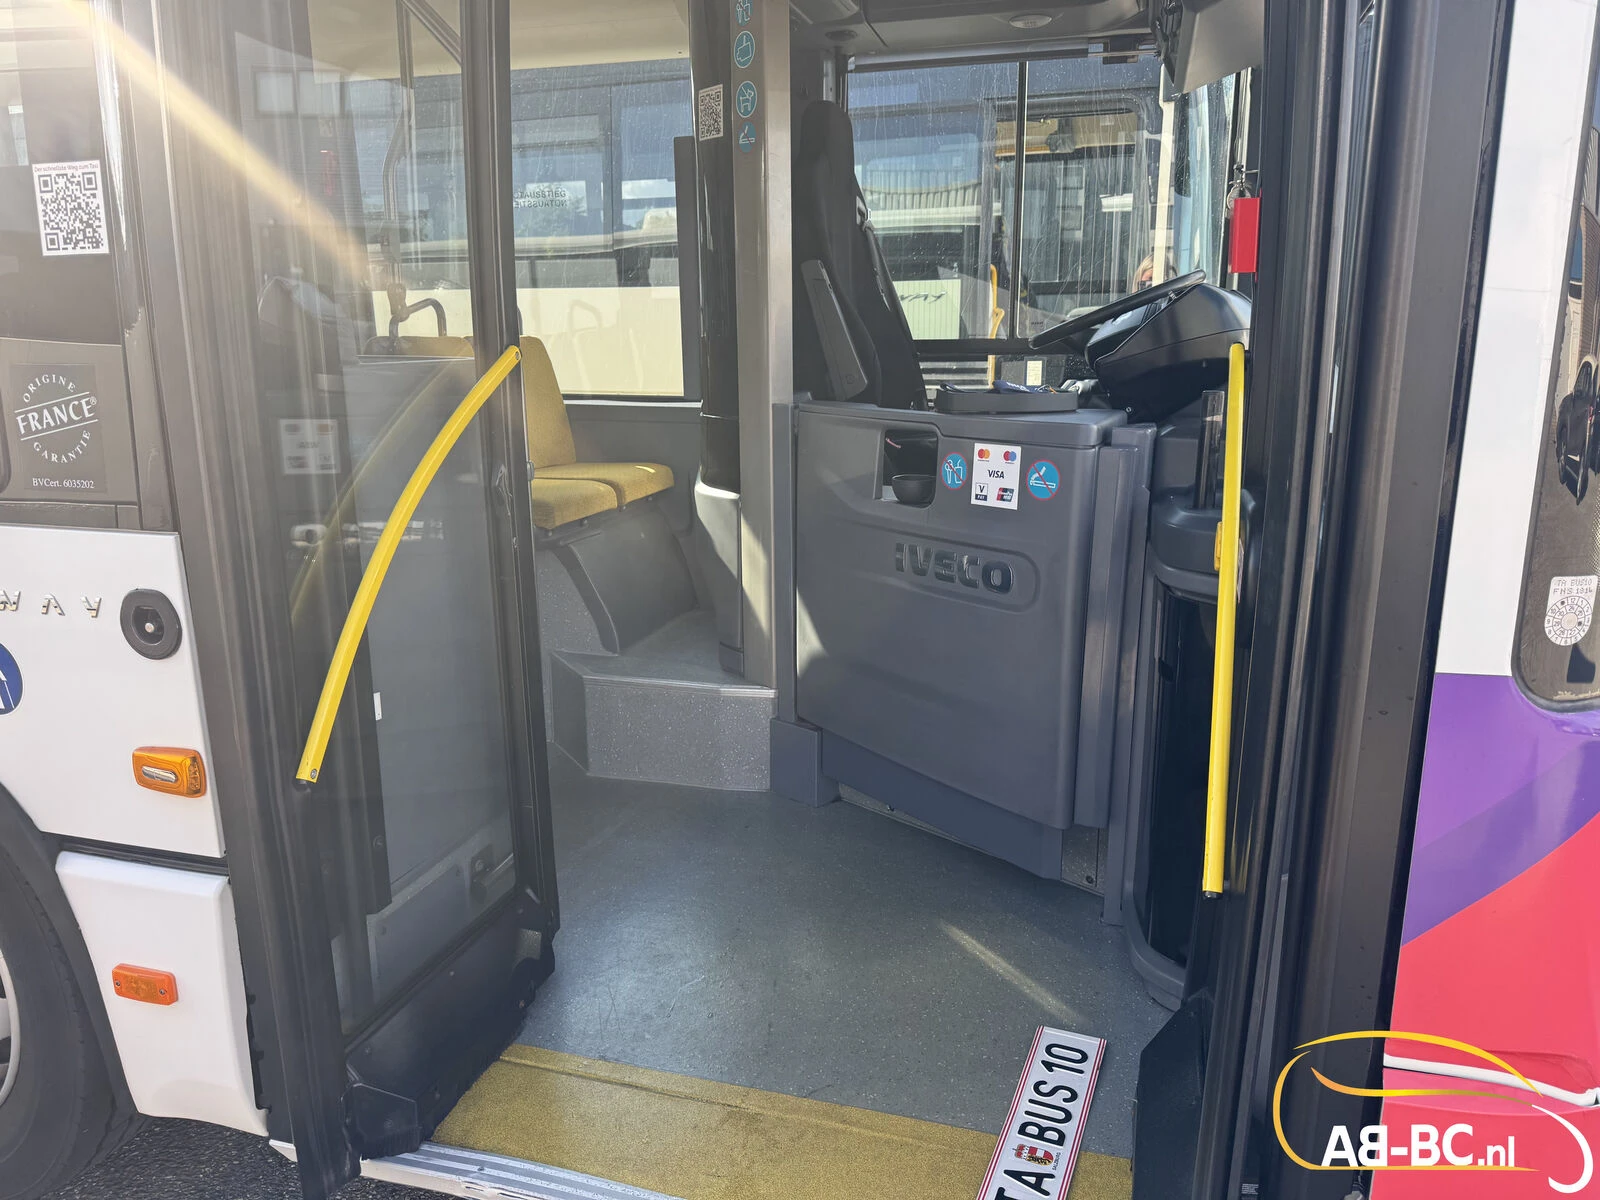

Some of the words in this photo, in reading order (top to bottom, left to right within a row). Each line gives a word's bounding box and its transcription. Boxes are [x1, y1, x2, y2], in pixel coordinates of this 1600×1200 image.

[513, 189, 567, 199] OTAUSSTIEG
[23, 374, 76, 403] ORIGINE
[16, 397, 96, 435] FRANCE
[33, 430, 91, 463] GARANTIE
[32, 477, 62, 487] BVCert.
[63, 478, 95, 489] 6035202
[987, 469, 1005, 479] VISA
[895, 542, 1014, 595] IVECO
[1040, 1043, 1089, 1075] 10
[1018, 1080, 1078, 1147] BUS
